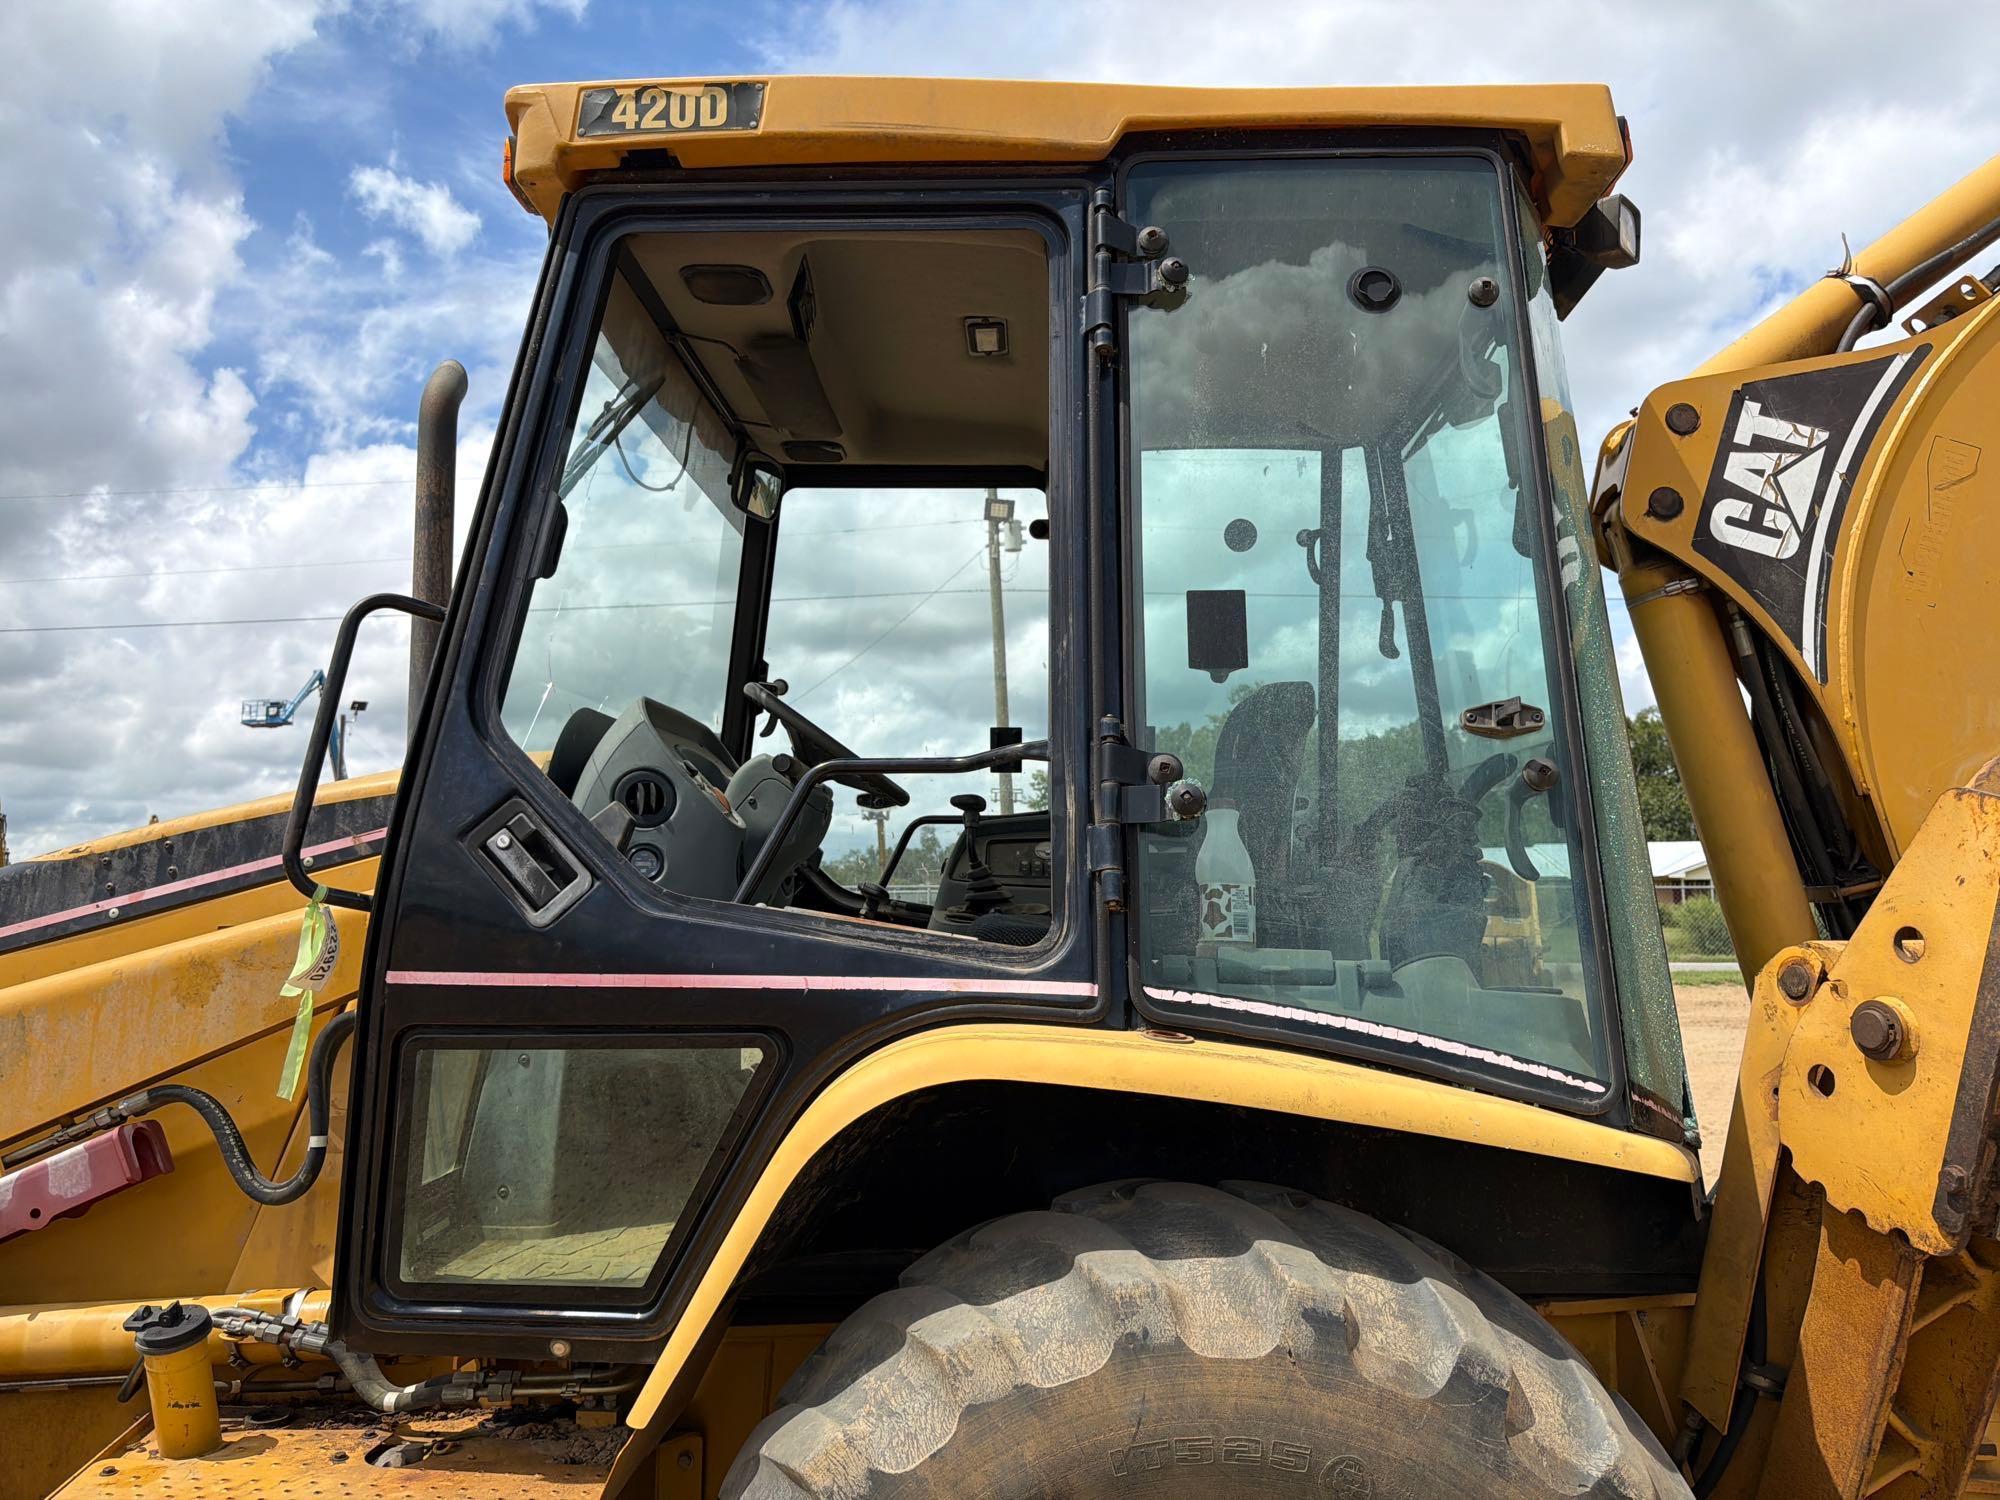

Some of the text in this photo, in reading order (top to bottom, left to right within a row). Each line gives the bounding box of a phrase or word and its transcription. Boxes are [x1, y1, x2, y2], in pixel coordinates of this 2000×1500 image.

[611, 86, 728, 131] 420D
[1709, 399, 1830, 560] CAT
[309, 924, 340, 981] 223920
[1109, 1436, 1312, 1477] IT525
